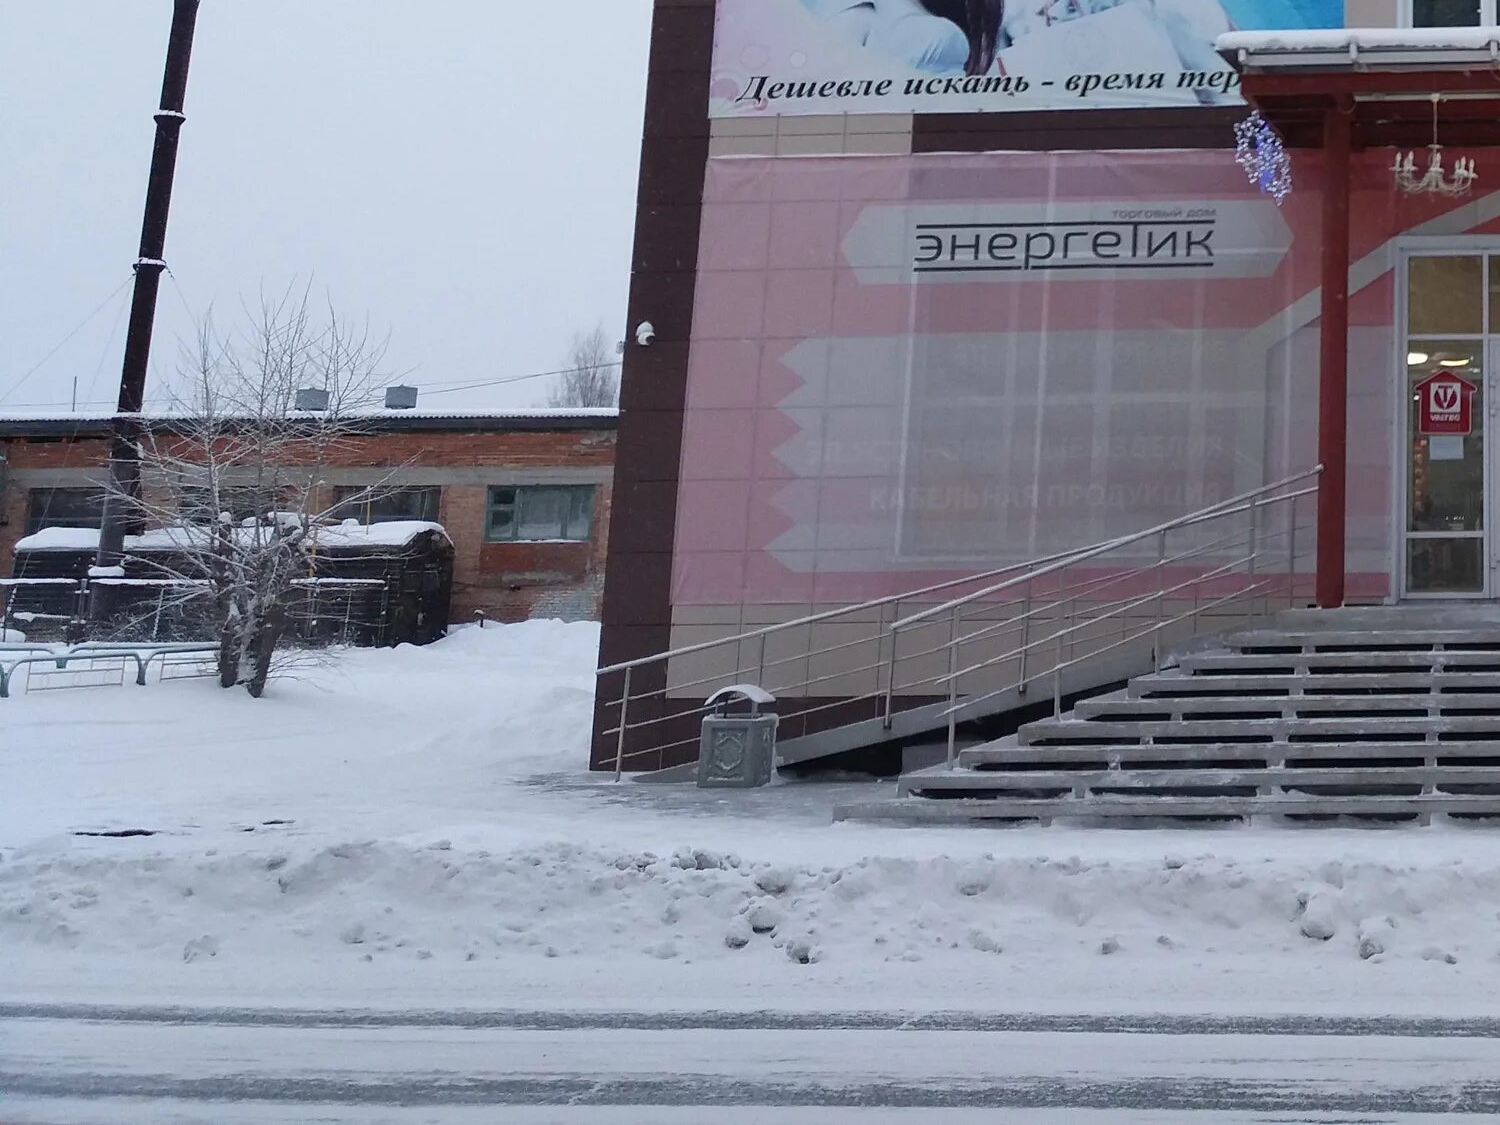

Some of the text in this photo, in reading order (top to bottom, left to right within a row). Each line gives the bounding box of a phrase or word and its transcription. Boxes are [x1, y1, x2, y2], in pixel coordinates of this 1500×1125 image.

[735, 75, 892, 103] Дешевле
[903, 73, 1030, 98] искать
[1064, 71, 1165, 97] время
[1176, 70, 1241, 94] тер
